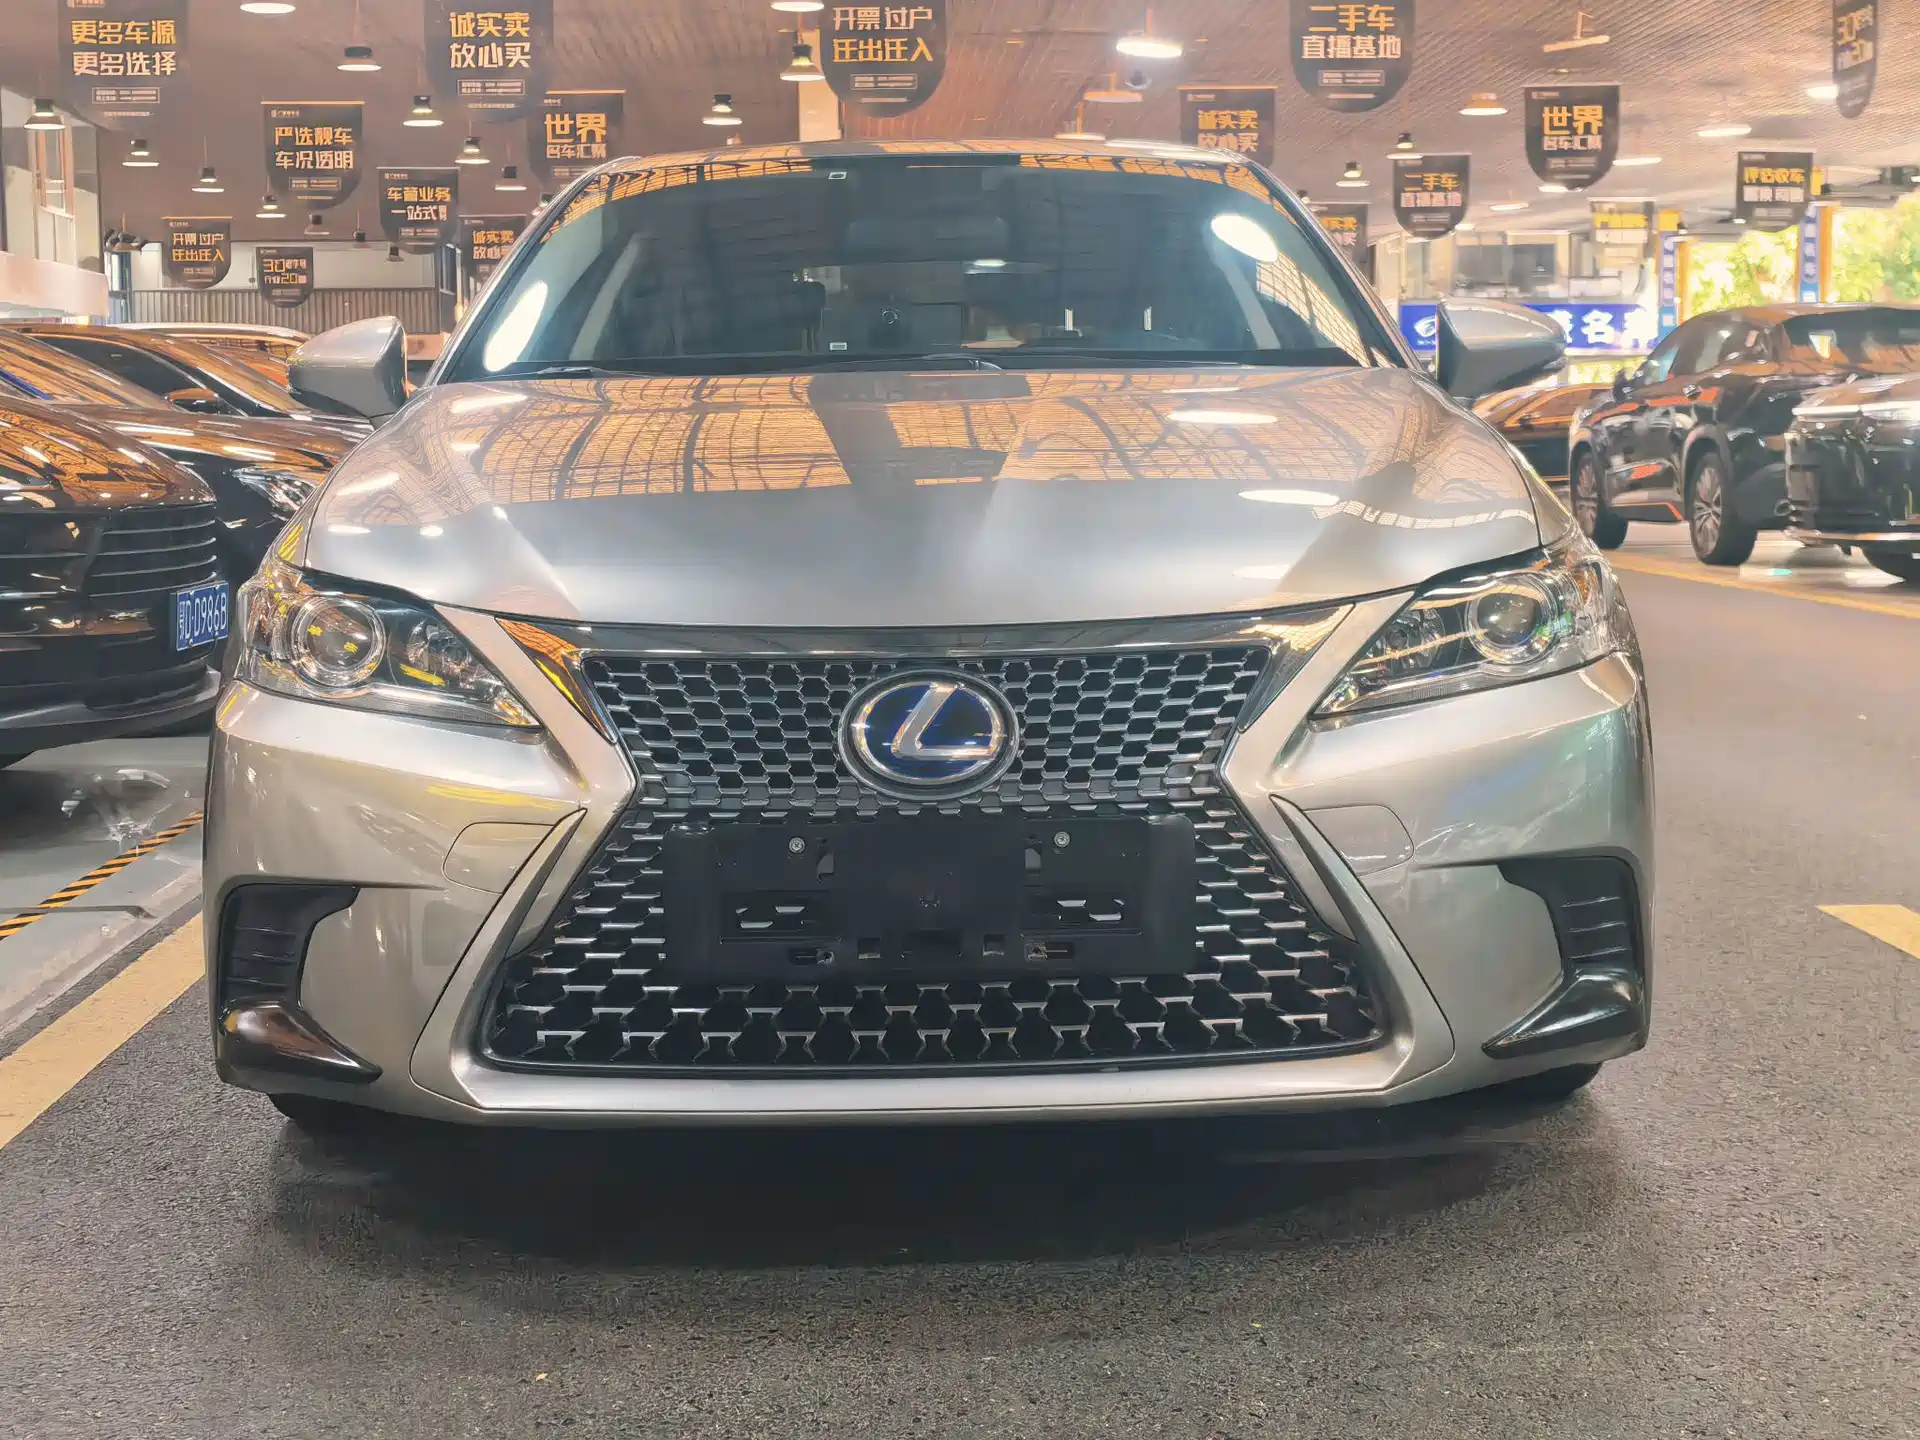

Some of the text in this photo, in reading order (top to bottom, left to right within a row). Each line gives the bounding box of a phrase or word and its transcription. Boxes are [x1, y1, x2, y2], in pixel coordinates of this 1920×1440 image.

[449, 12, 530, 38] 诚实卖
[833, 6, 933, 30] 开票过户
[1308, 4, 1396, 31] 二手车
[72, 20, 176, 44] 更多车源
[450, 42, 531, 68] 放心买
[1301, 35, 1401, 59] 直播基地
[73, 51, 176, 76] 更多选择
[544, 113, 606, 143] 世界
[1542, 105, 1603, 135] 世界
[274, 126, 353, 146] 严选靓车
[275, 150, 354, 169] 车况透明
